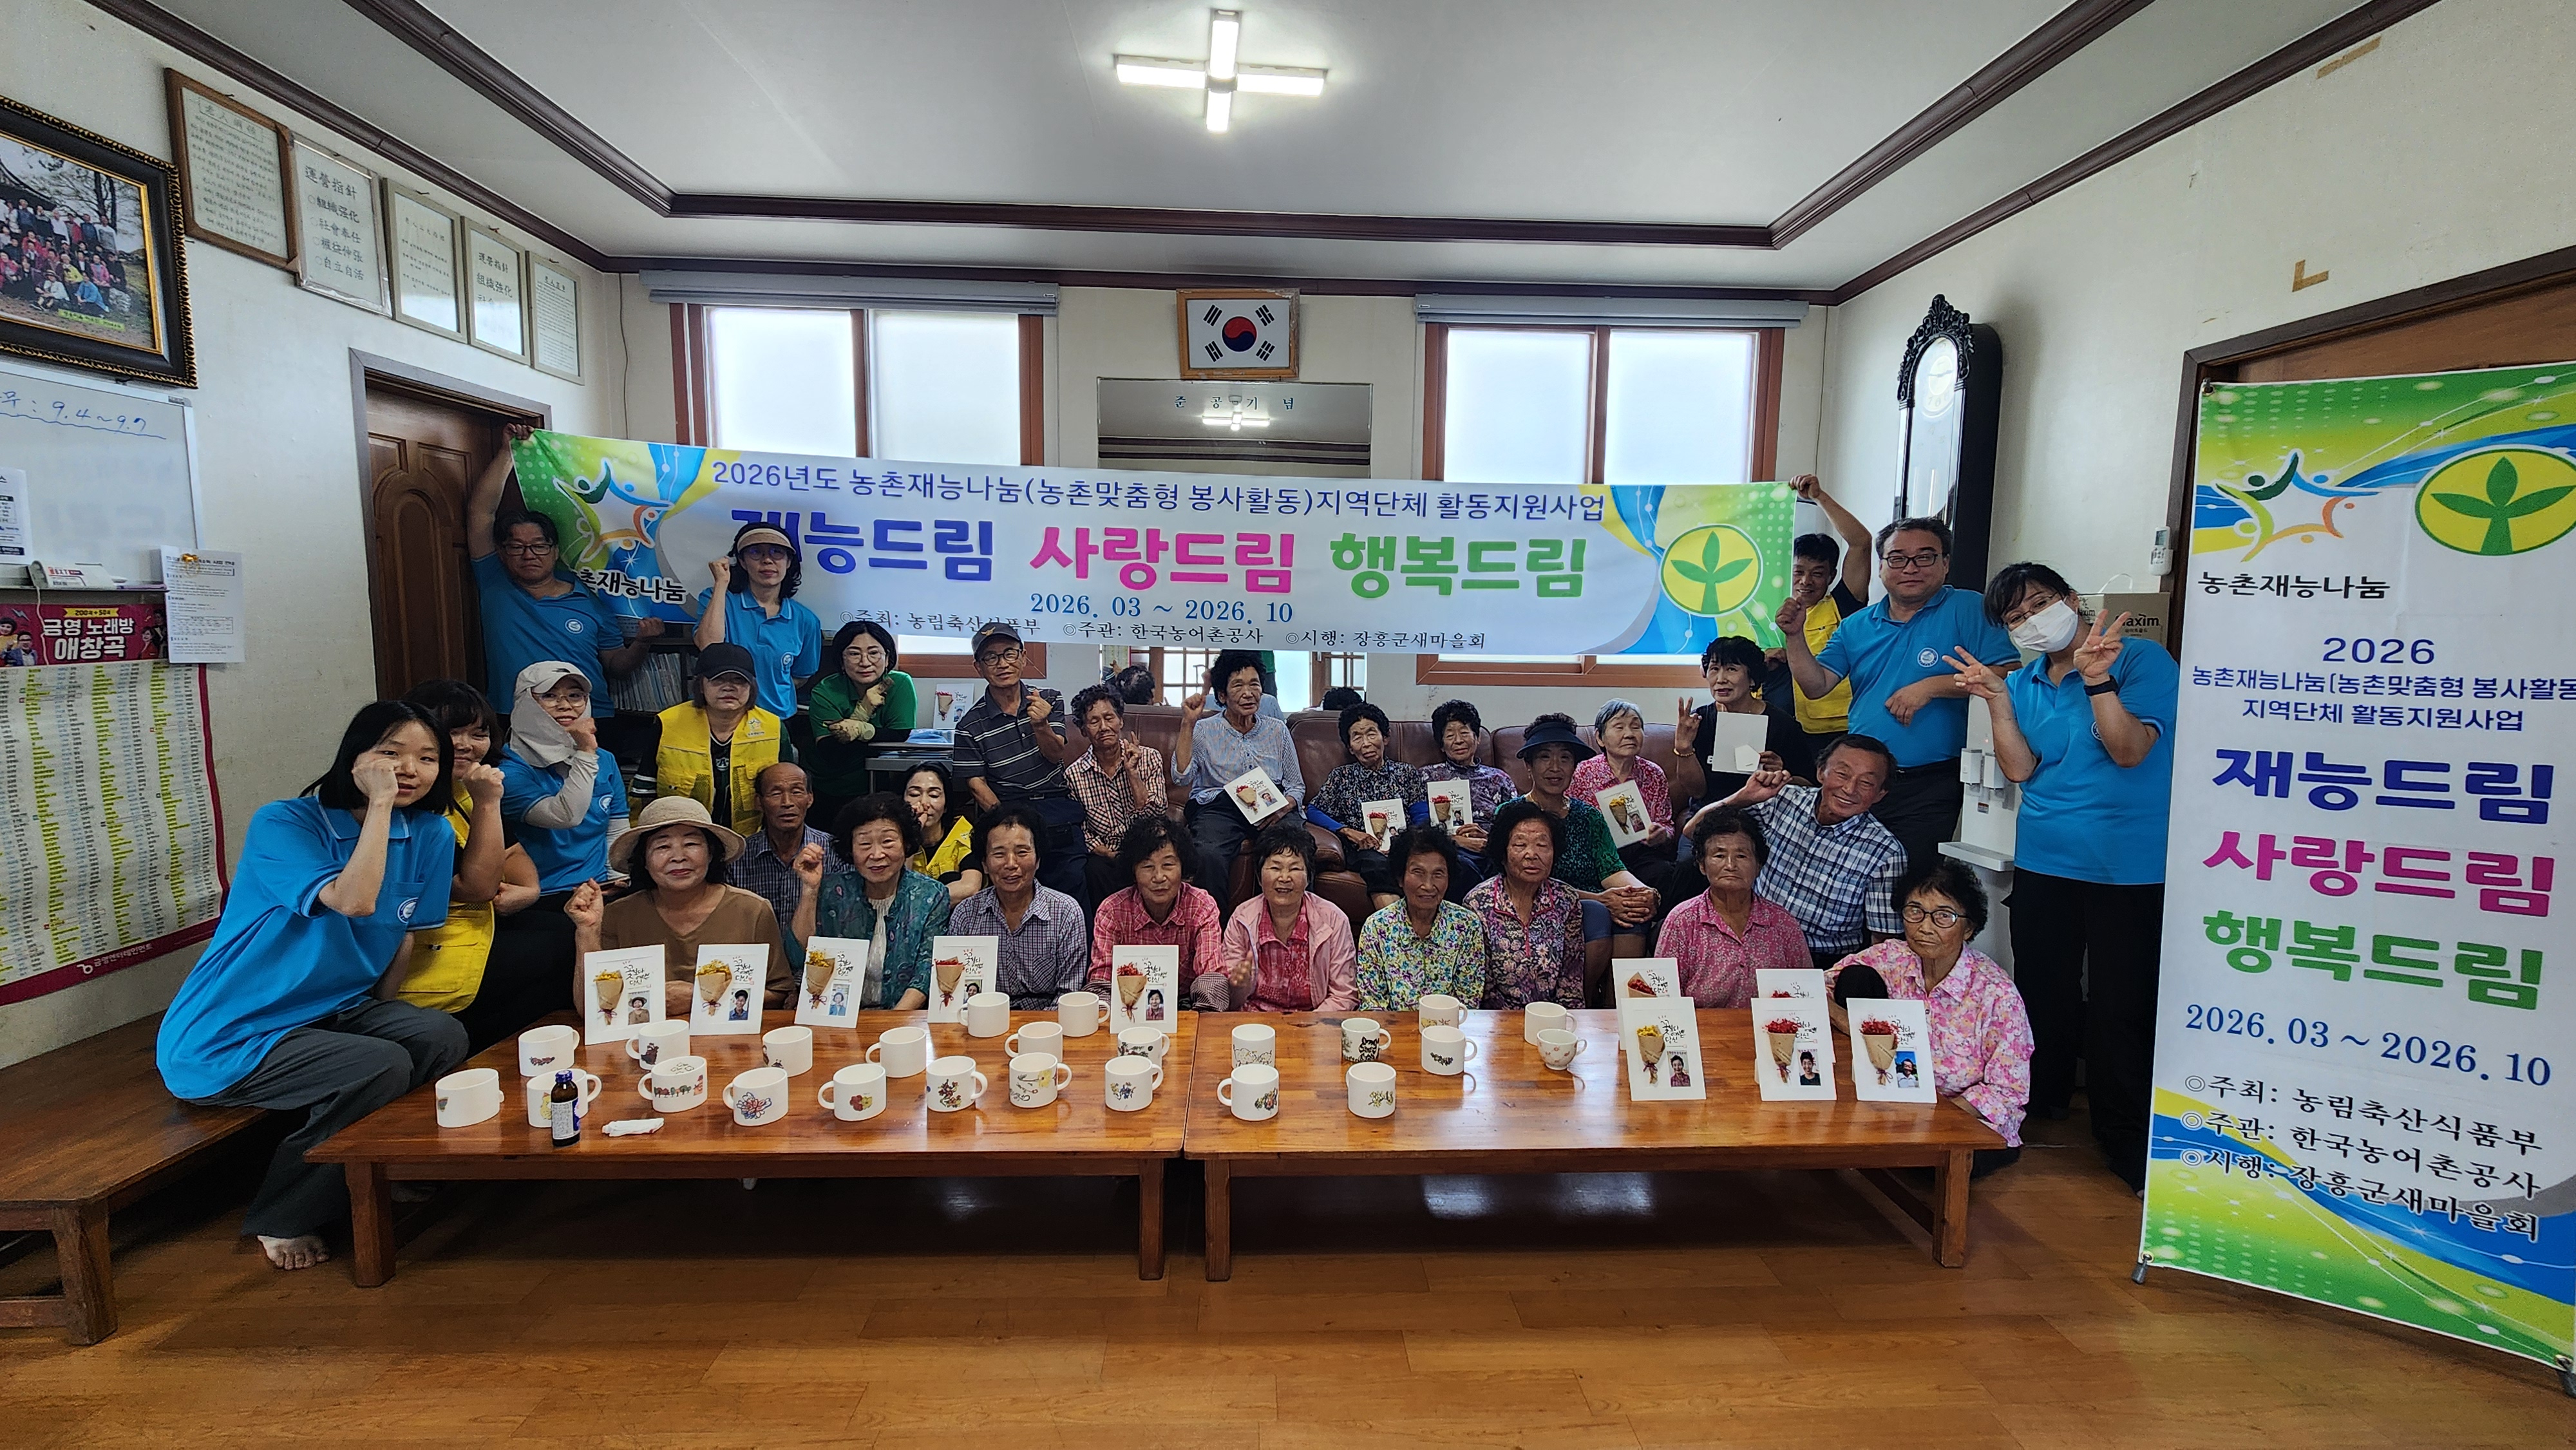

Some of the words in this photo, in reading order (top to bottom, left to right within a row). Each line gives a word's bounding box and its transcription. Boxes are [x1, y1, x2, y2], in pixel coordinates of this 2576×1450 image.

[712, 461, 840, 491] 2026년도
[849, 469, 1179, 509] 농촌재능나눔(농촌맞춤형
[1188, 484, 1428, 519] 봉사활동)지역단체
[1435, 491, 1605, 522] 활동지원사업
[574, 569, 686, 601] 촌재능나눔
[1029, 526, 1294, 594] 사랑드림
[1330, 532, 1587, 599] 행복드림
[2197, 572, 2391, 599] 농촌재능나눔
[43, 618, 82, 637] 금영
[86, 617, 134, 636] 노래방
[1112, 596, 1142, 617] 03
[1266, 602, 1293, 623] 10
[54, 636, 126, 661] 애창곡
[1130, 622, 1264, 645] 한국농어촌공사
[1352, 631, 1486, 650] 장흥군새마을회
[2322, 637, 2436, 665] 2026
[2192, 665, 2464, 699] 농촌재능나눔(농촌맞춤형
[2242, 699, 2344, 724] 지역단체
[2351, 704, 2524, 732] 활동지원사업
[2212, 748, 2554, 825] 재능드림
[2202, 831, 2555, 918] 사랑드림
[2202, 910, 2543, 1011] 행복드림
[2287, 1017, 2330, 1049] 03
[2506, 1053, 2552, 1087] 10
[2293, 1088, 2543, 1156] 농림축산식품부
[2291, 1125, 2541, 1200] 한국농어촌공사
[2289, 1163, 2539, 1243] 장흥군새마을회
